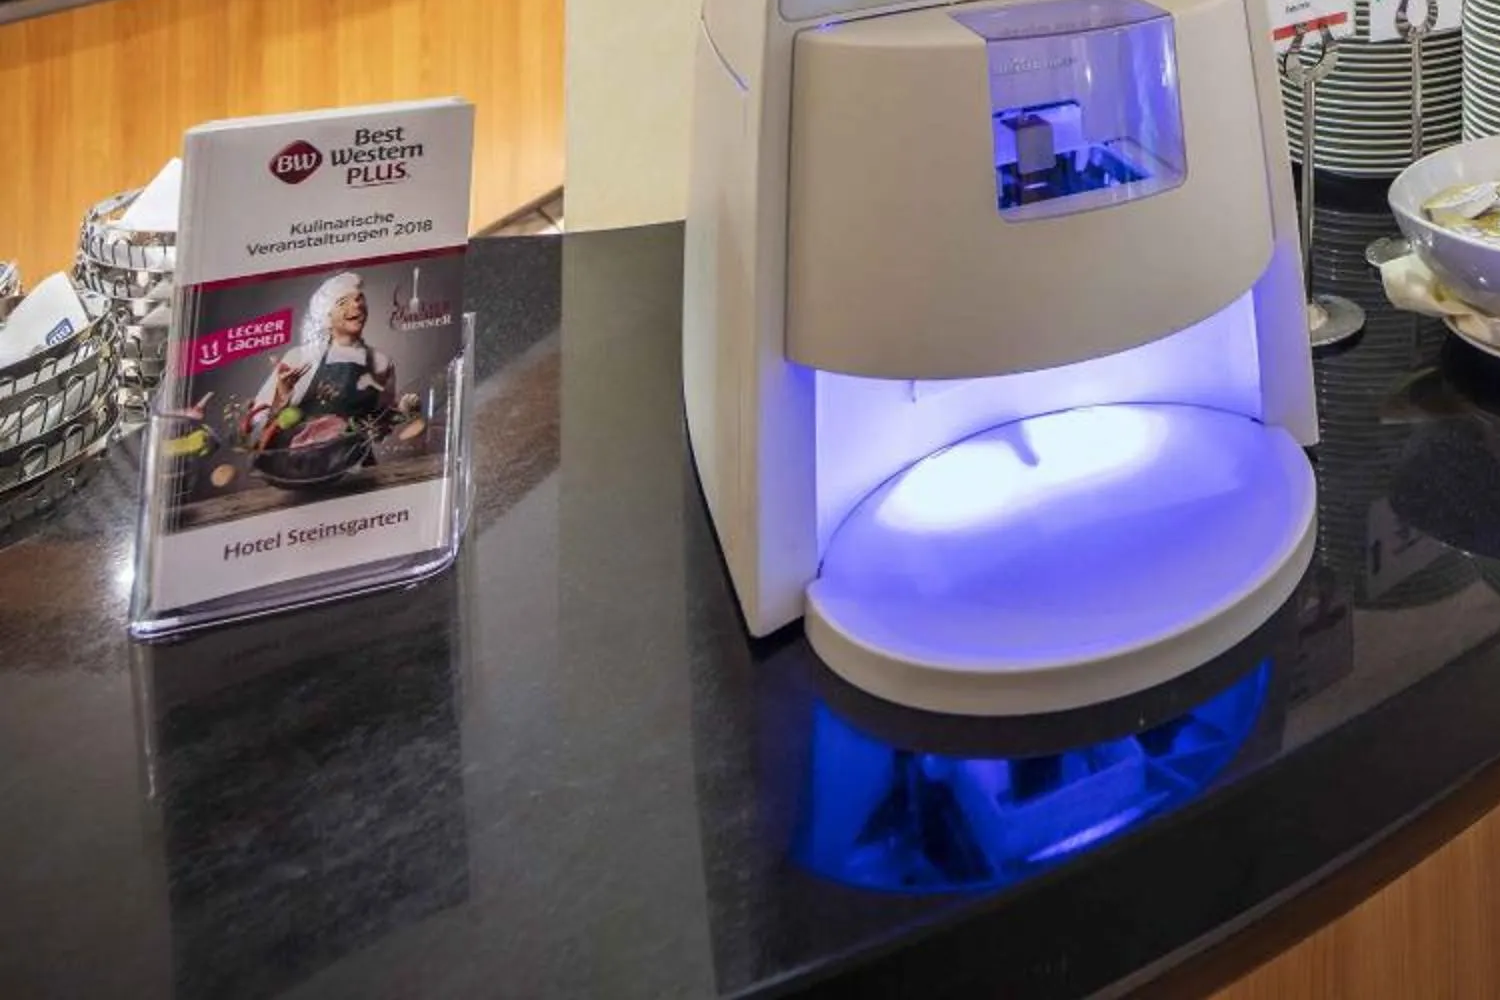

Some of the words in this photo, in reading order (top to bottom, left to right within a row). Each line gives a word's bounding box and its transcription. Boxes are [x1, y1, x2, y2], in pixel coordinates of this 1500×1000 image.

[355, 126, 406, 146] Best
[276, 152, 317, 173] BW
[329, 143, 424, 166] Western
[346, 161, 407, 184] PLUS
[290, 211, 395, 235] Kulinarische
[246, 226, 389, 256] Veranstaltungen
[394, 219, 433, 236] 2018
[222, 532, 282, 561] Hotel
[287, 509, 410, 547] Steinsgarten
